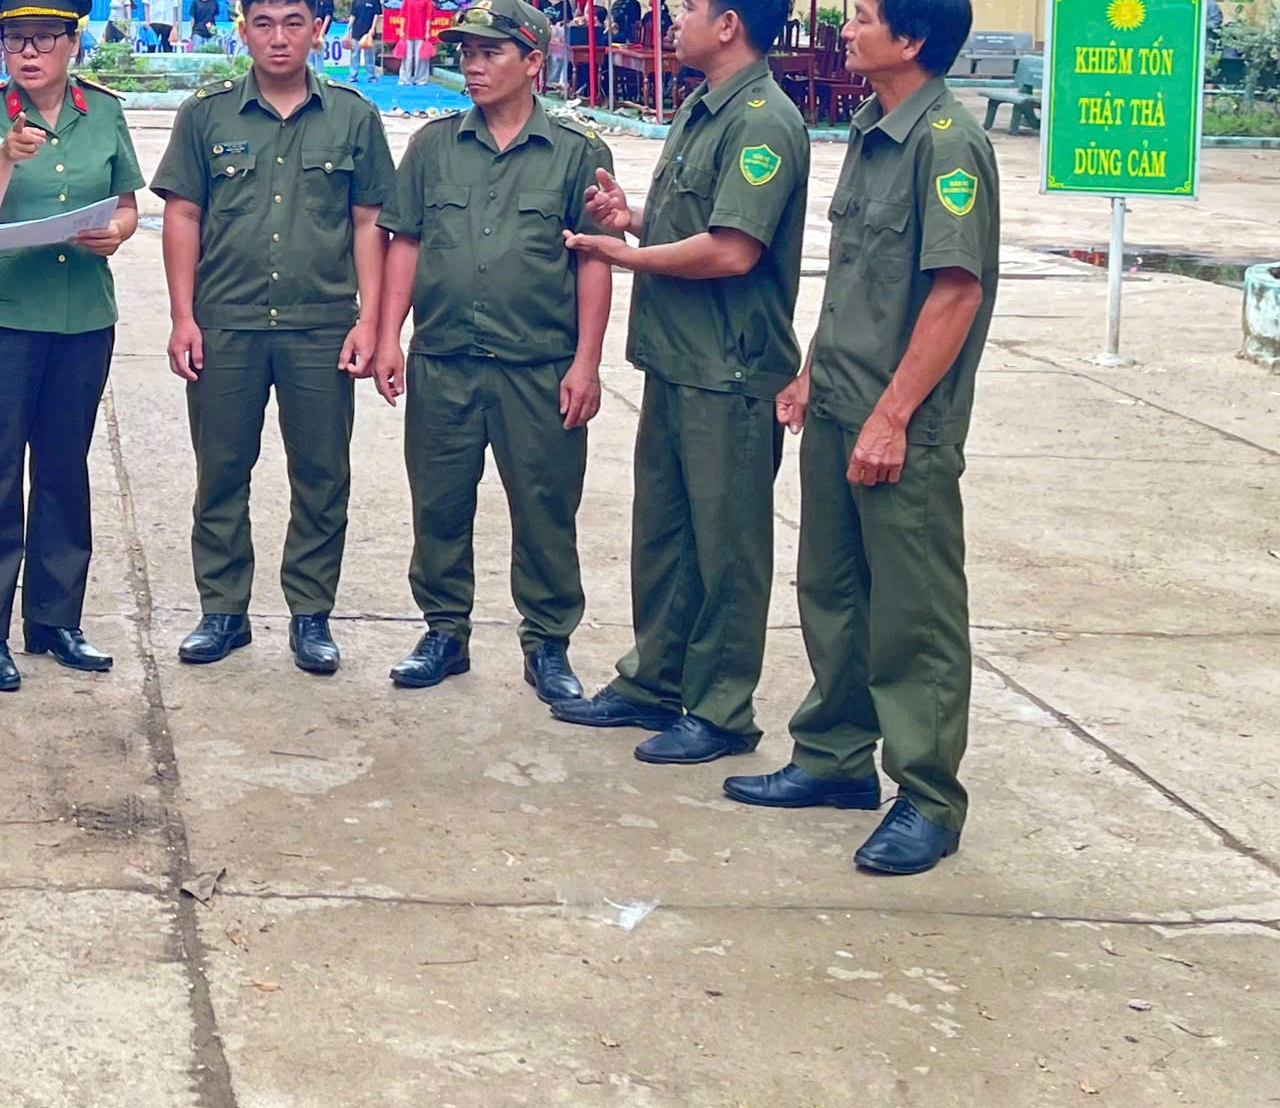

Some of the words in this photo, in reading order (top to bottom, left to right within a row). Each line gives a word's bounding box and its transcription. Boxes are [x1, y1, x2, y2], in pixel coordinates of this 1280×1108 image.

[1075, 40, 1133, 74] KHIÊM
[1139, 36, 1173, 75] TỐN
[1079, 90, 1124, 132] THẬT
[1131, 92, 1166, 126] THÀ
[1074, 141, 1122, 176] DŨNG
[1127, 140, 1166, 177] CẢM
